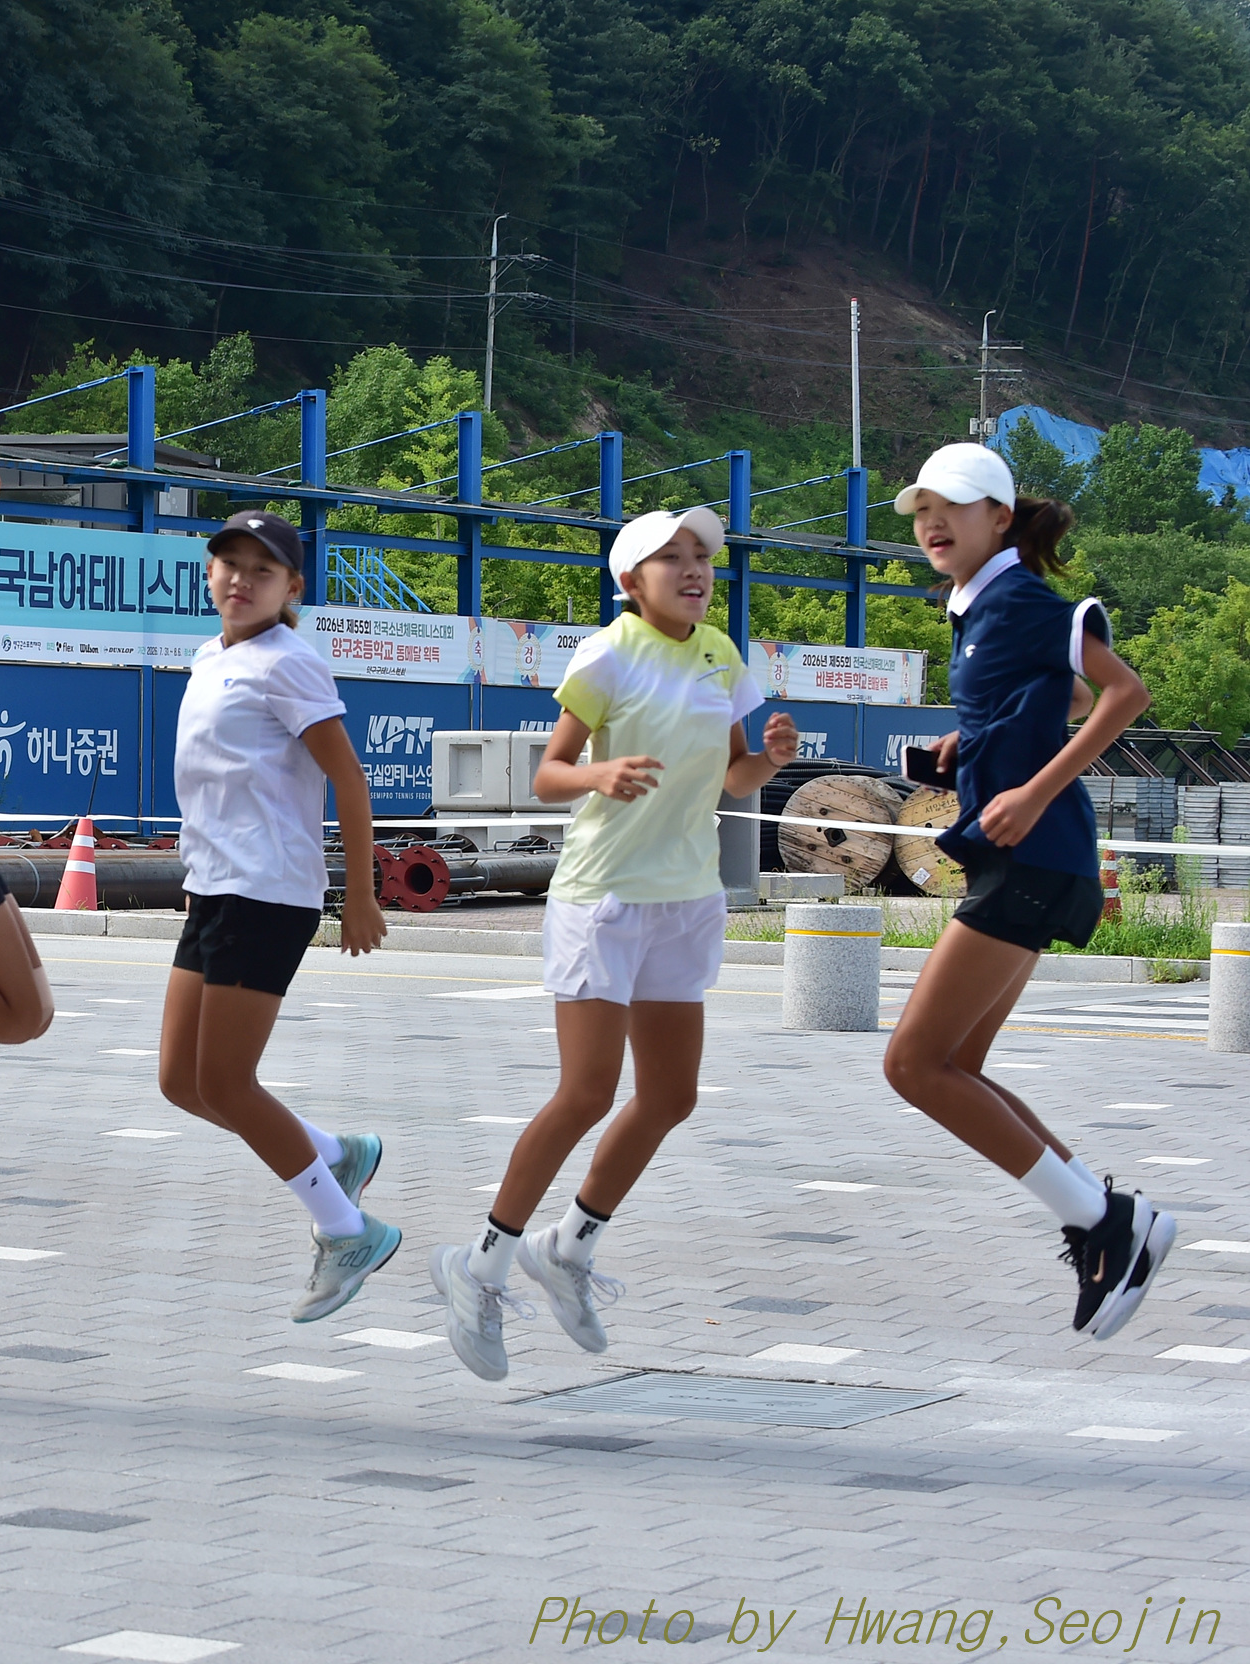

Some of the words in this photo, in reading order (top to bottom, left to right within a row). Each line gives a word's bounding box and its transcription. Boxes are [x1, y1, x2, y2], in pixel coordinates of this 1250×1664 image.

[316, 617, 344, 633] 2026년
[346, 619, 372, 635] 제55회
[373, 621, 454, 640] 전국소년체육테니스대회
[63, 642, 74, 653] flex
[79, 643, 99, 654] Wilson
[108, 646, 135, 654] DUNLOP
[332, 637, 394, 661] 양구초등학교
[423, 646, 440, 663] 획득
[475, 640, 482, 659] 축
[524, 646, 533, 665] 경
[802, 654, 828, 668] 2026년
[829, 655, 851, 668] 제55회
[774, 664, 782, 681] 경
[815, 671, 867, 690] 비봉초등학교
[365, 715, 434, 754] KPTF
[27, 727, 118, 776] 하나증권
[360, 764, 432, 787] 국실업테니스
